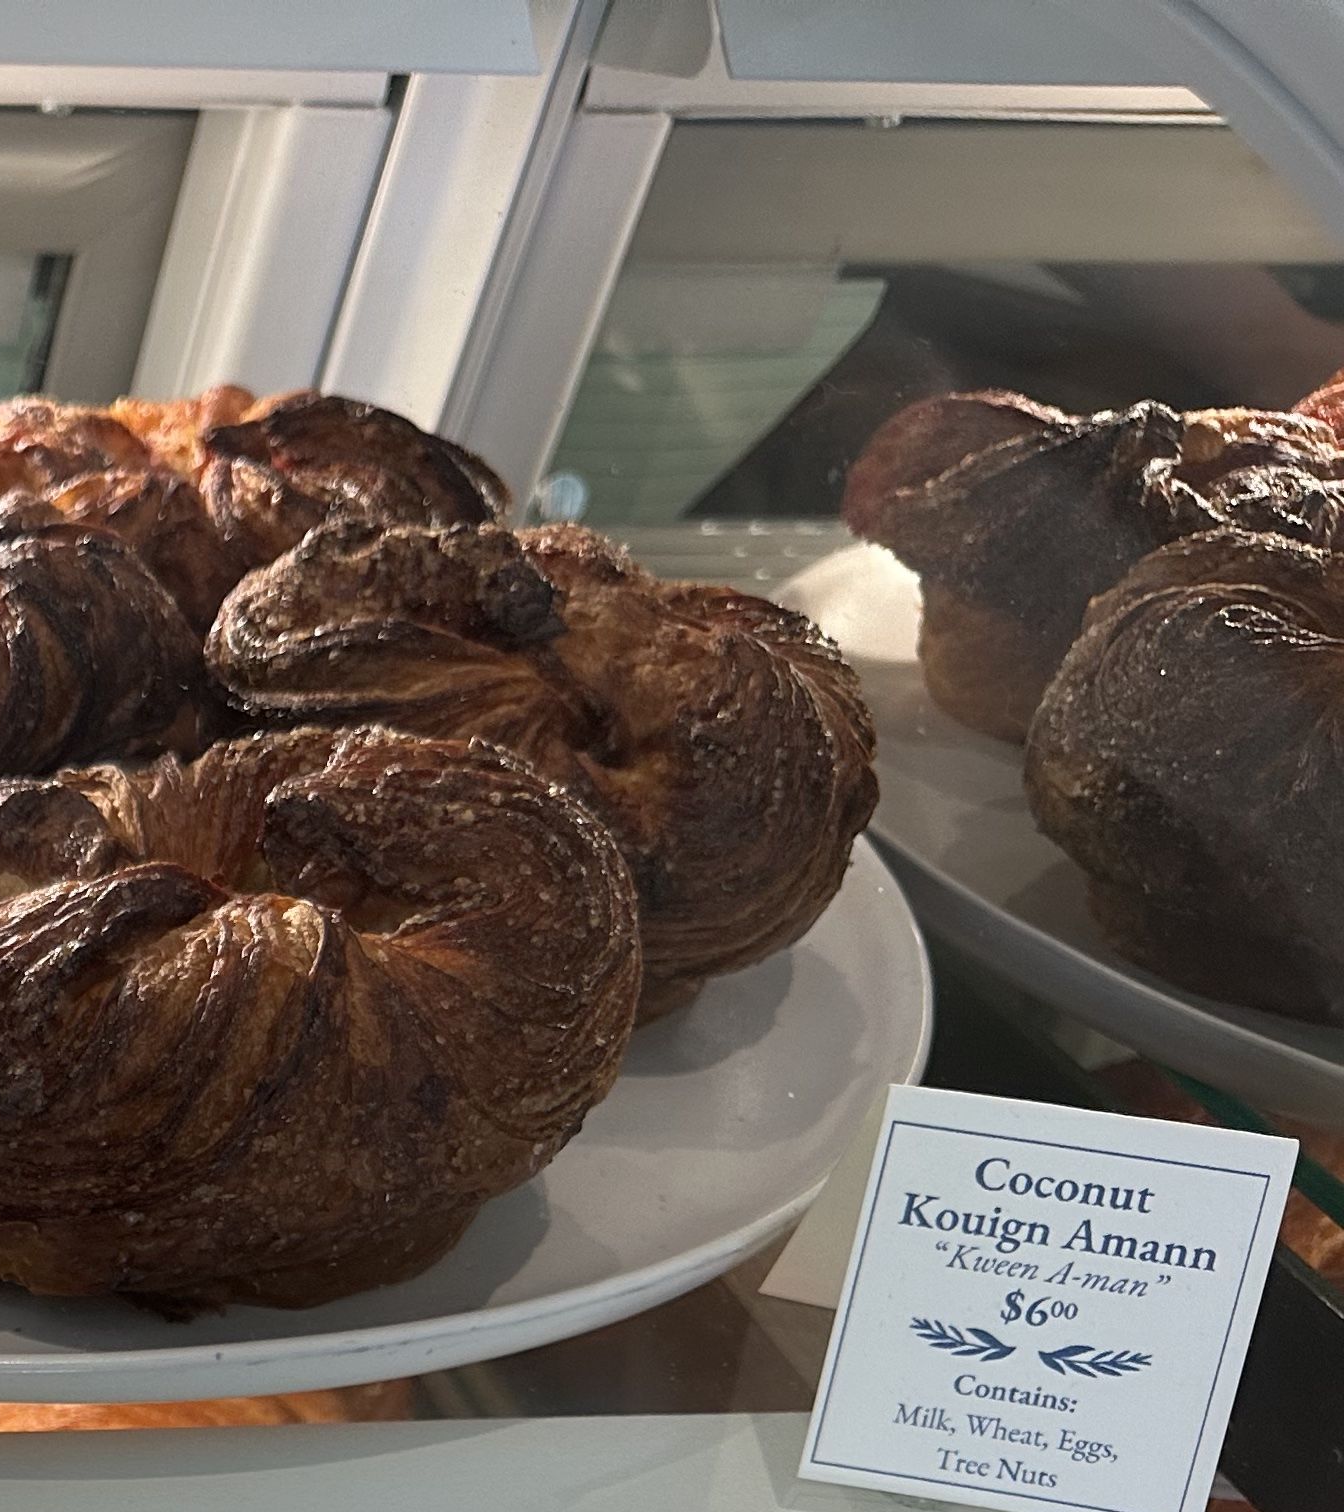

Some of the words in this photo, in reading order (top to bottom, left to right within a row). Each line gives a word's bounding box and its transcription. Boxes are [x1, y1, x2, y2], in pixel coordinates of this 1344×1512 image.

[975, 1157, 1156, 1215] Coconut
[897, 1192, 1050, 1254] Kouign
[1060, 1218, 1217, 1273] Amann
[953, 1374, 1078, 1414] Contains:
[892, 1402, 956, 1435] Milk,
[966, 1413, 1049, 1451] Wheat,
[1056, 1428, 1118, 1464] Eggs,
[937, 1447, 991, 1478] Tree
[995, 1457, 1058, 1488] Nuts
